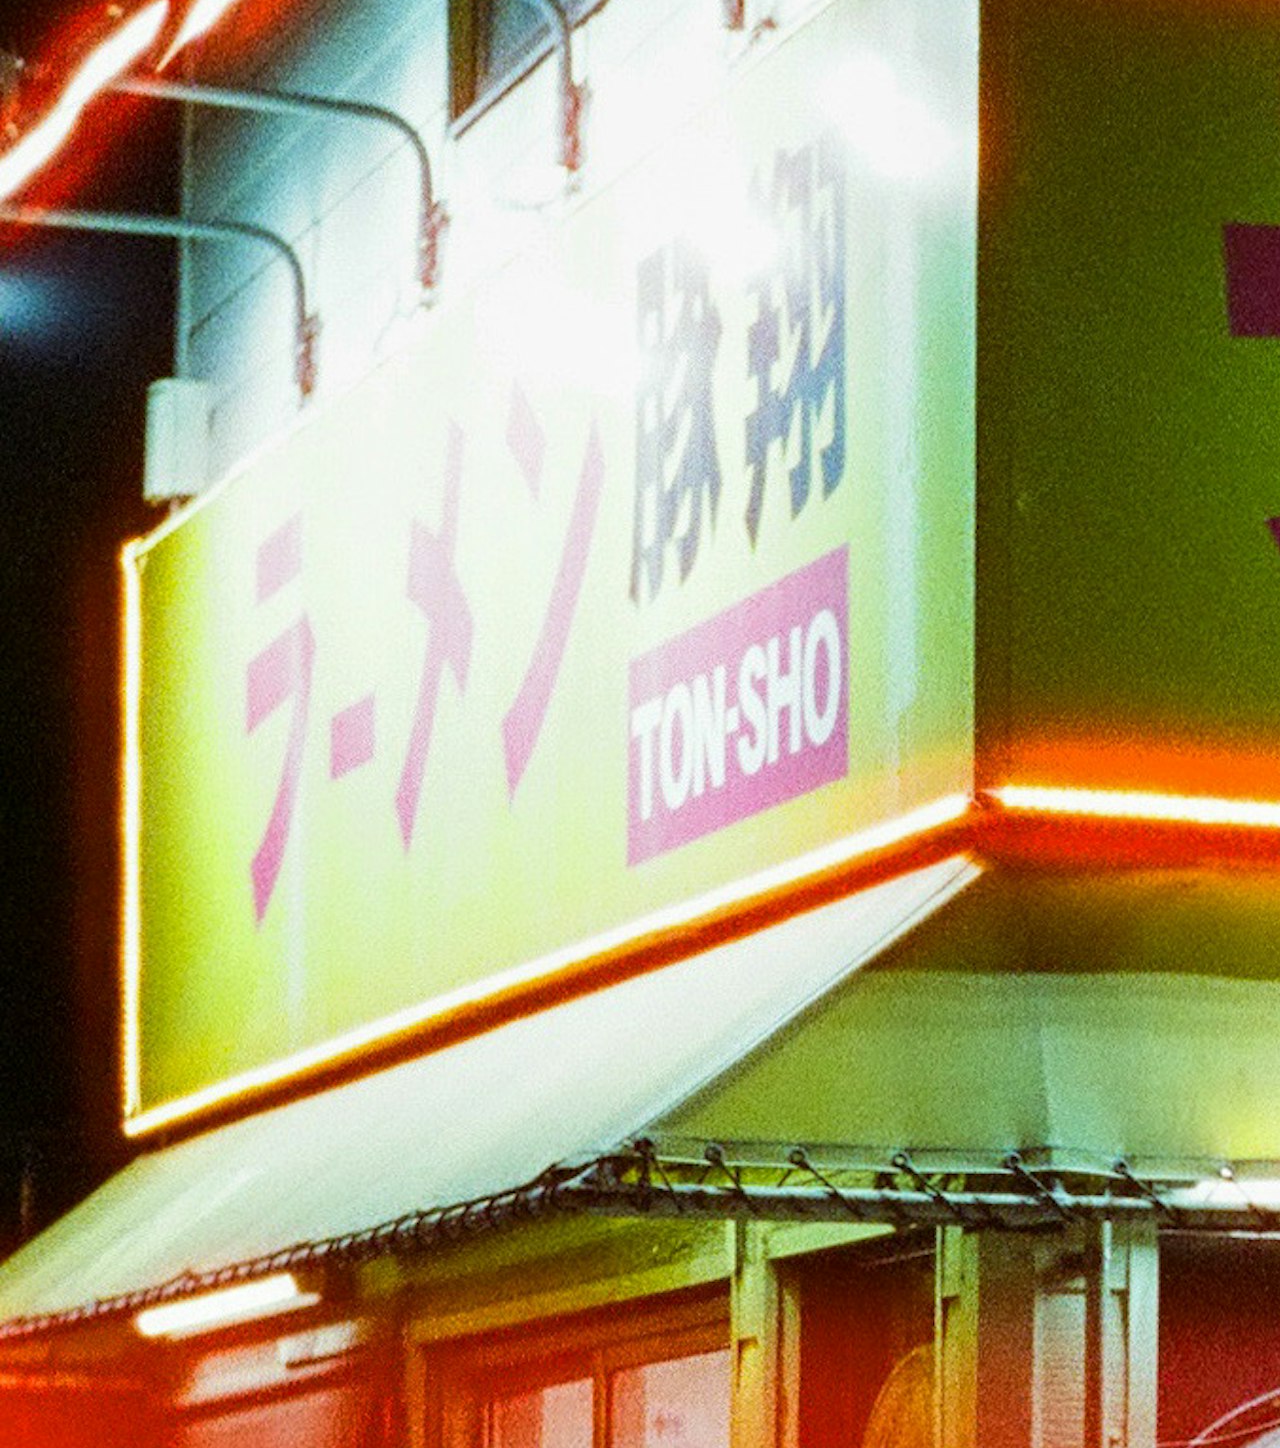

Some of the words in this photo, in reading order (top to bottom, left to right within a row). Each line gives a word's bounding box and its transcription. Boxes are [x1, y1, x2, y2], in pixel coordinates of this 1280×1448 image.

[246, 382, 604, 930] ラーメン
[631, 608, 841, 818] TON-SHO
